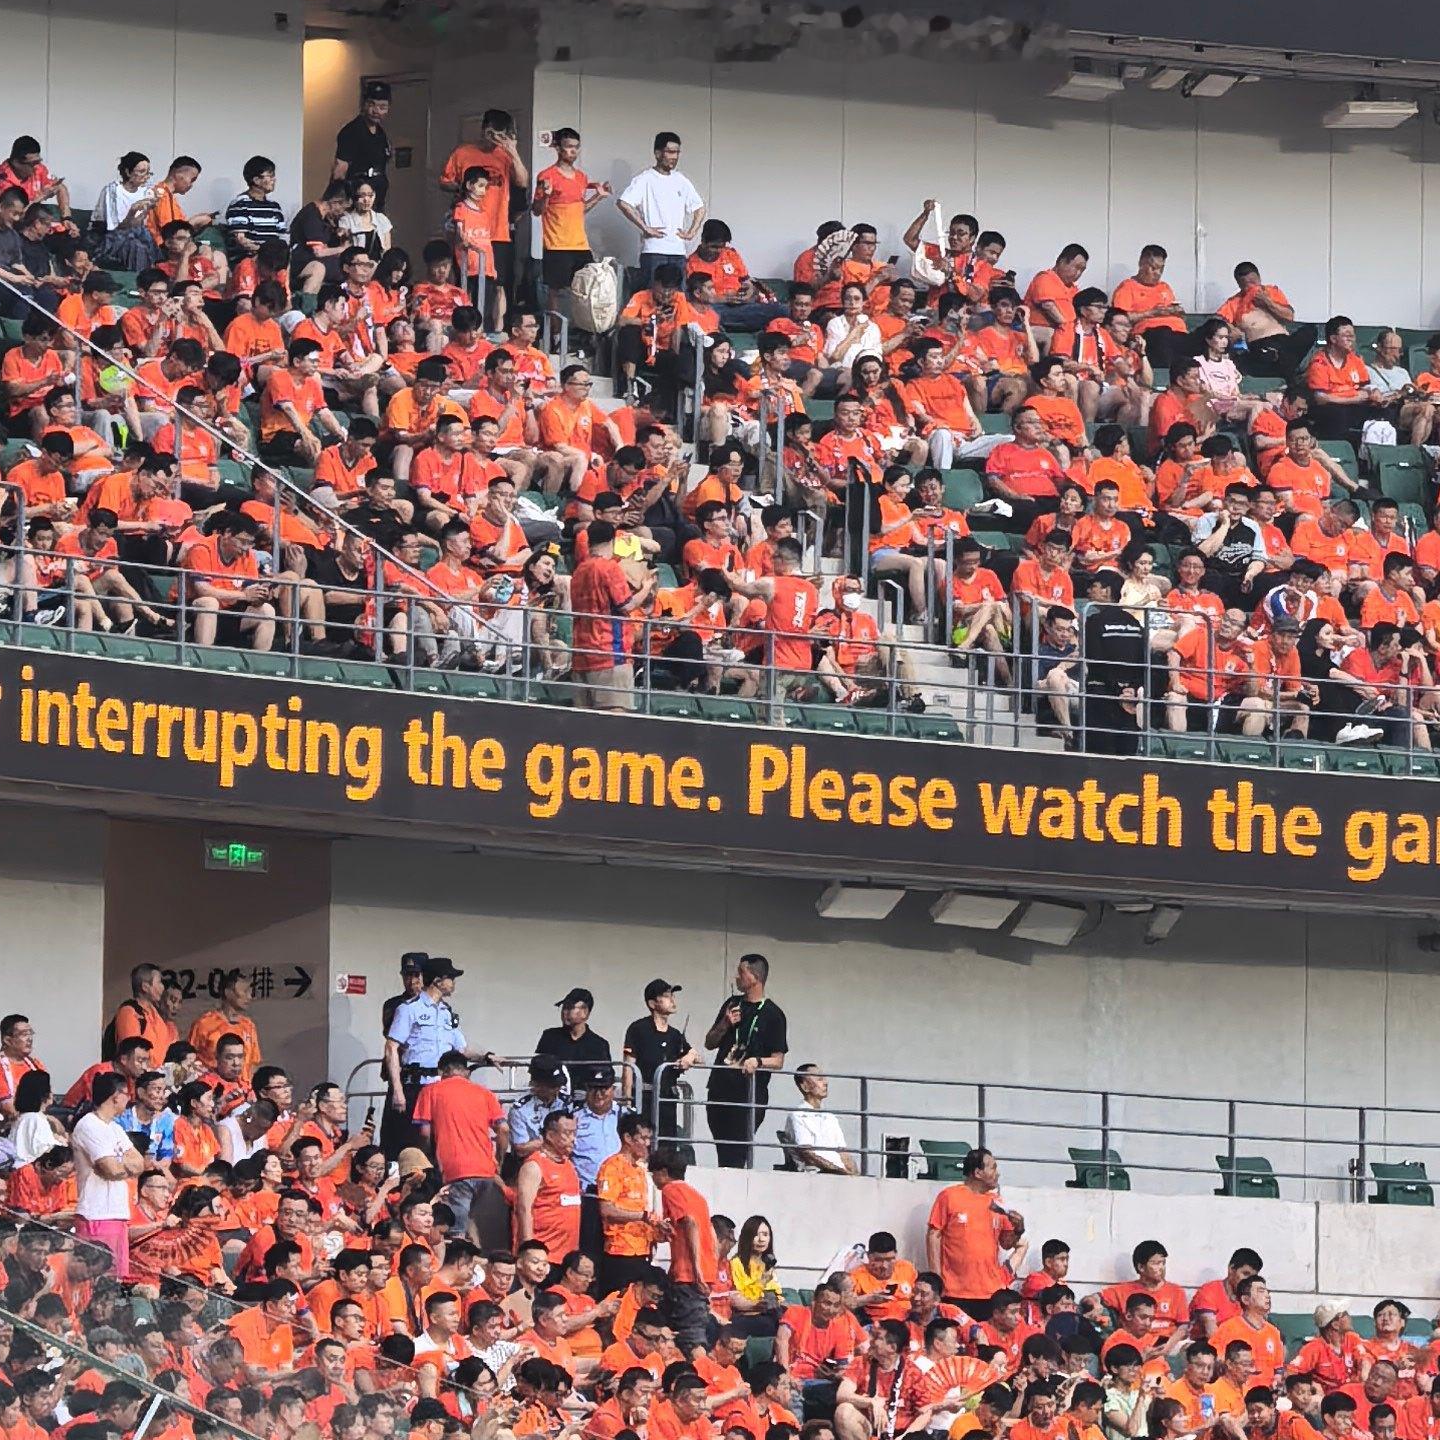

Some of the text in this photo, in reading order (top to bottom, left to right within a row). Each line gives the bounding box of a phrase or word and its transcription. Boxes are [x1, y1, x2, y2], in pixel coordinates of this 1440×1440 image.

[20, 666, 382, 801] interrupting
[402, 711, 505, 791] the
[524, 743, 720, 818] game.
[747, 744, 956, 830] Please
[978, 773, 1181, 848] watch
[1207, 780, 1321, 857] the
